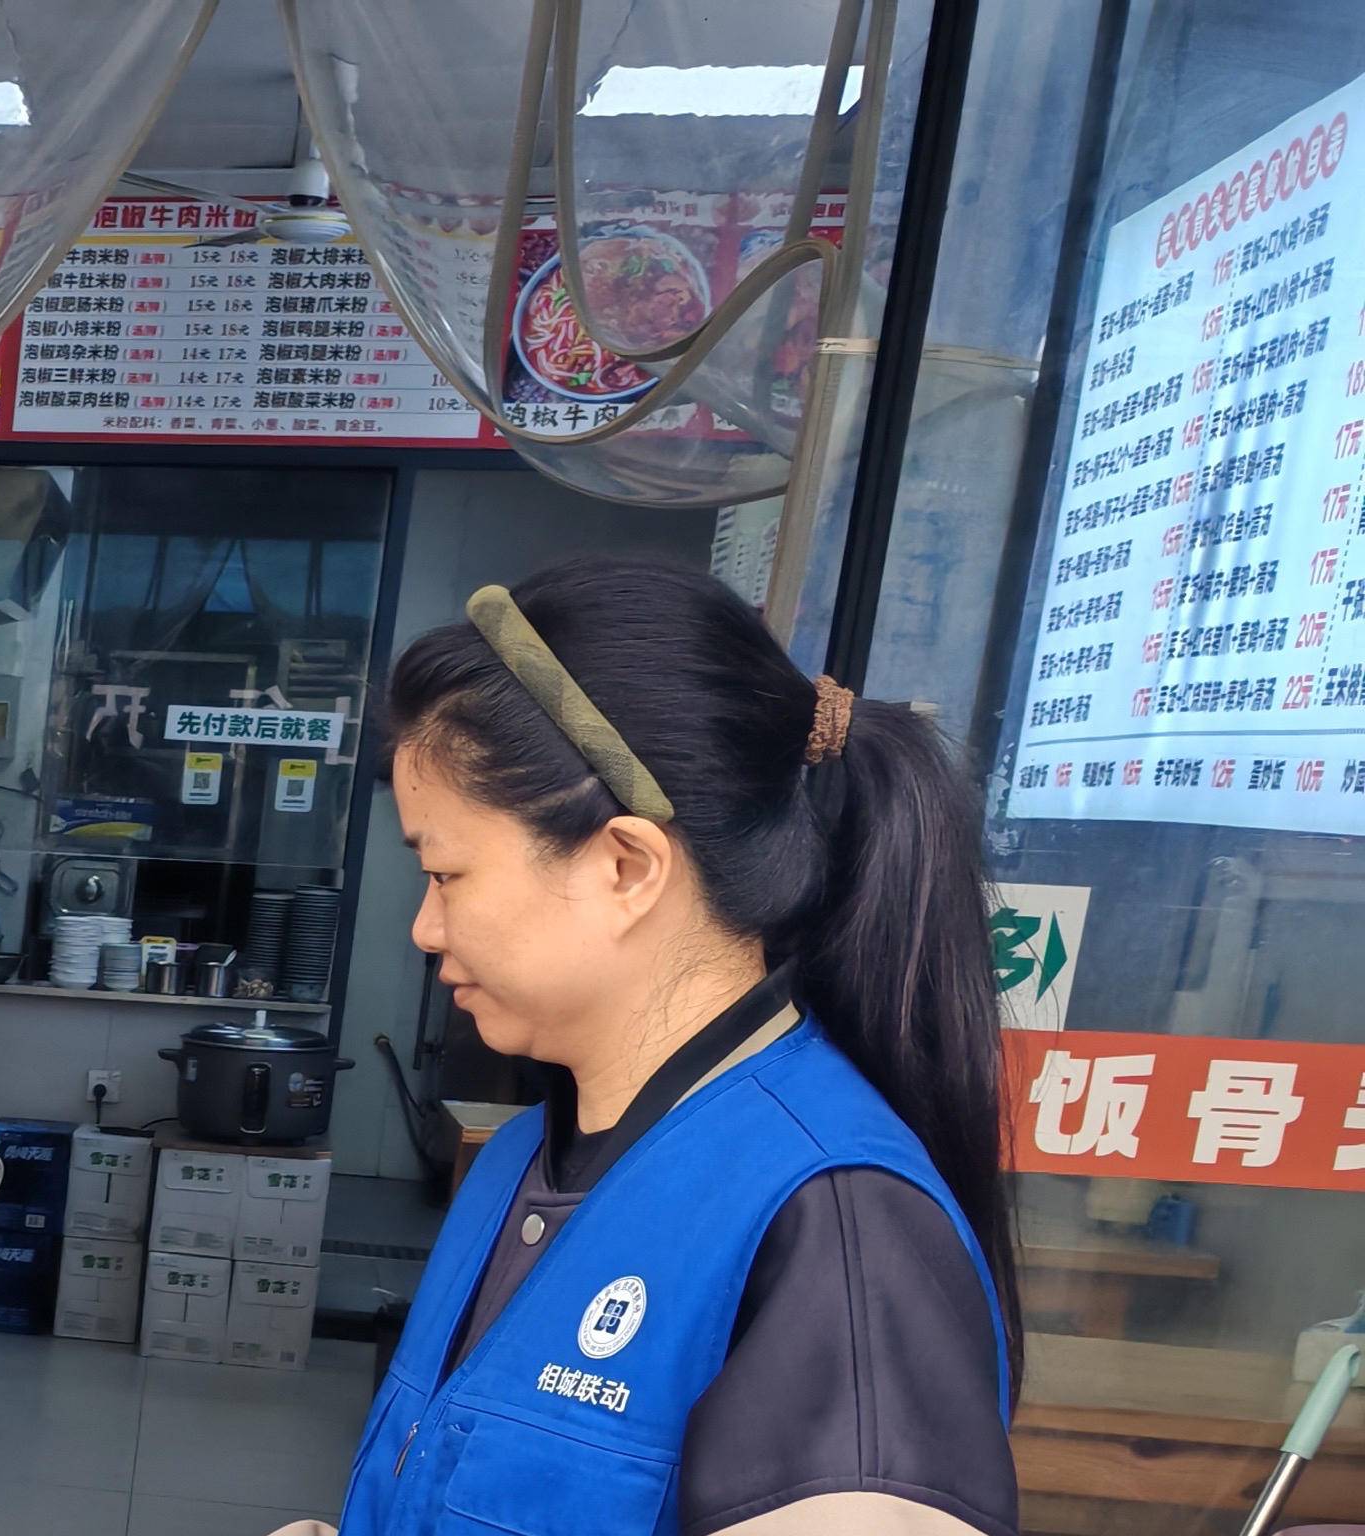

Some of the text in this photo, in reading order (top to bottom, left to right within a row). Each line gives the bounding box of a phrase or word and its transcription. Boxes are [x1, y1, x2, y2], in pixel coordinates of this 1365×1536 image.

[268, 272, 371, 289] 泡椒大肉米粉
[265, 296, 368, 314] 泡椒猪爪米粉
[26, 320, 121, 337] 泡椒小排米粉
[261, 320, 364, 337] 泡椒鸭腿米粉
[24, 344, 119, 361] 泡椒鸡杂米粉
[259, 344, 362, 361] 泡椒鸡腿米粉
[22, 368, 116, 385] 泡椒三鲜米粉
[256, 368, 342, 385] 泡椒素米粉
[19, 392, 130, 409] 泡椒酸菜肉丝粉
[253, 392, 356, 409] 泡椒酸菜米粉
[1323, 484, 1352, 524] 17元
[1310, 548, 1339, 586] 17元
[1295, 611, 1327, 648] 20元
[1282, 674, 1315, 710] 22元
[176, 710, 332, 743] 先付款后就餐
[1296, 760, 1325, 792] 10元
[537, 1362, 632, 1414] 相城联动
